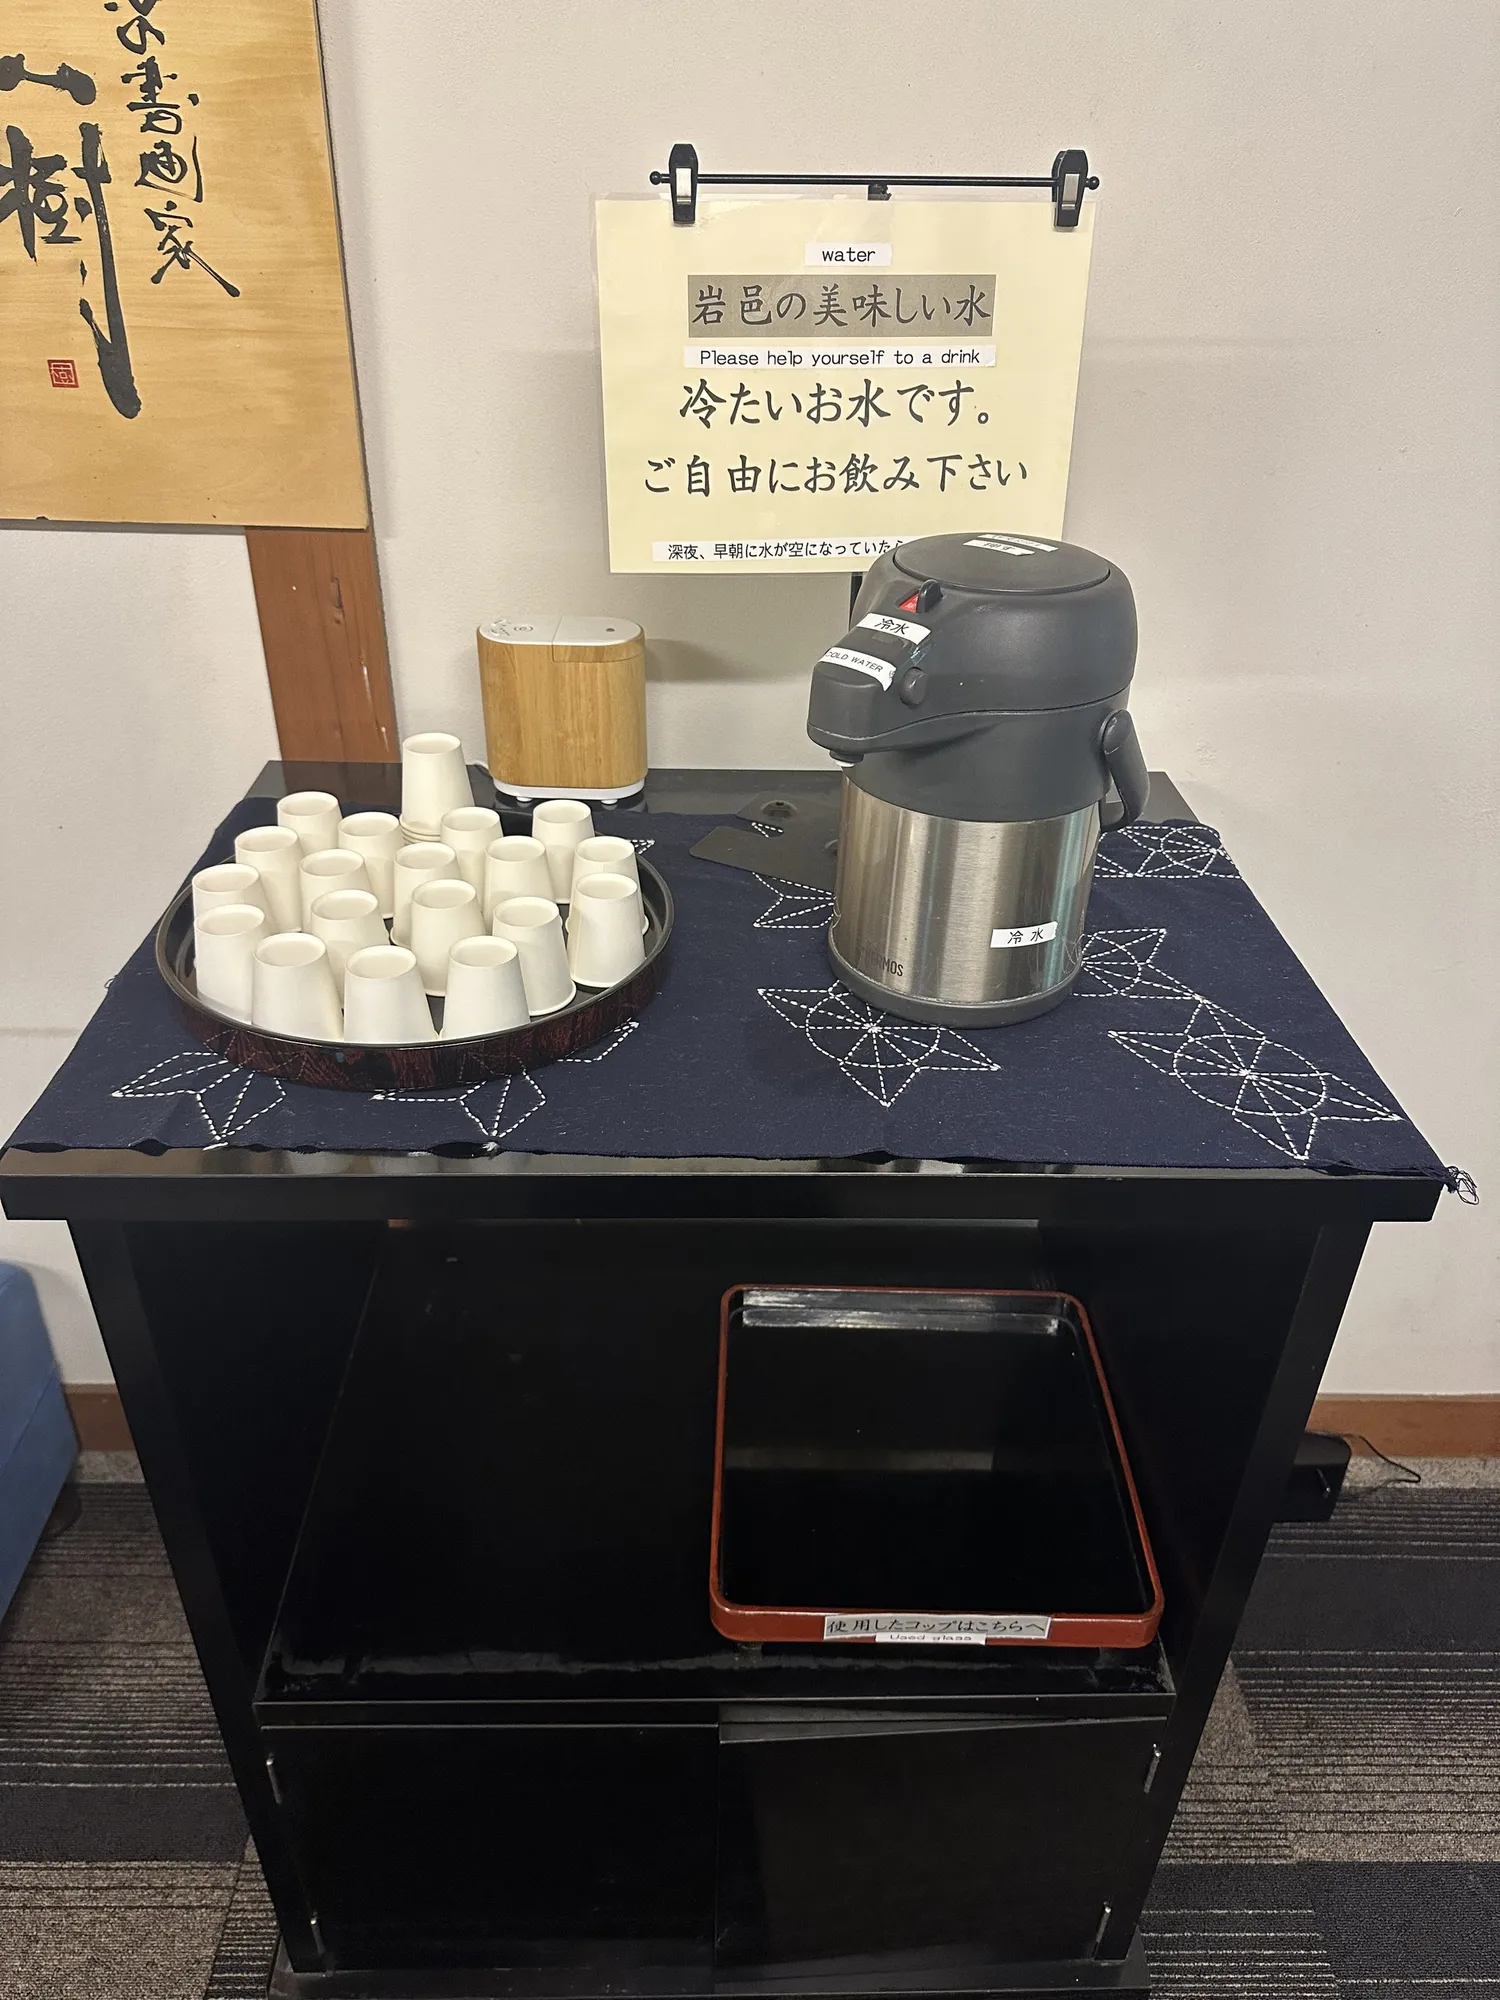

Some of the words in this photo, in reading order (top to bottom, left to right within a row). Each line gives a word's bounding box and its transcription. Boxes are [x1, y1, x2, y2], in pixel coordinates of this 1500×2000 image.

[822, 247, 875, 262] water
[692, 284, 990, 327] 岩邑の美味しい水
[701, 350, 758, 365] Please
[768, 351, 802, 366] help
[812, 350, 884, 366] yourself
[894, 351, 913, 364] to
[922, 354, 932, 363] a
[942, 349, 979, 363] drink
[680, 379, 988, 428] 冷たいお水です。
[646, 454, 1026, 497] ご自由にお飲み下さい
[874, 618, 910, 635] 冷水
[851, 656, 884, 673] WATER
[1007, 927, 1044, 945] 冷水
[827, 1618, 1045, 1633] 使用したコップはこちらへ
